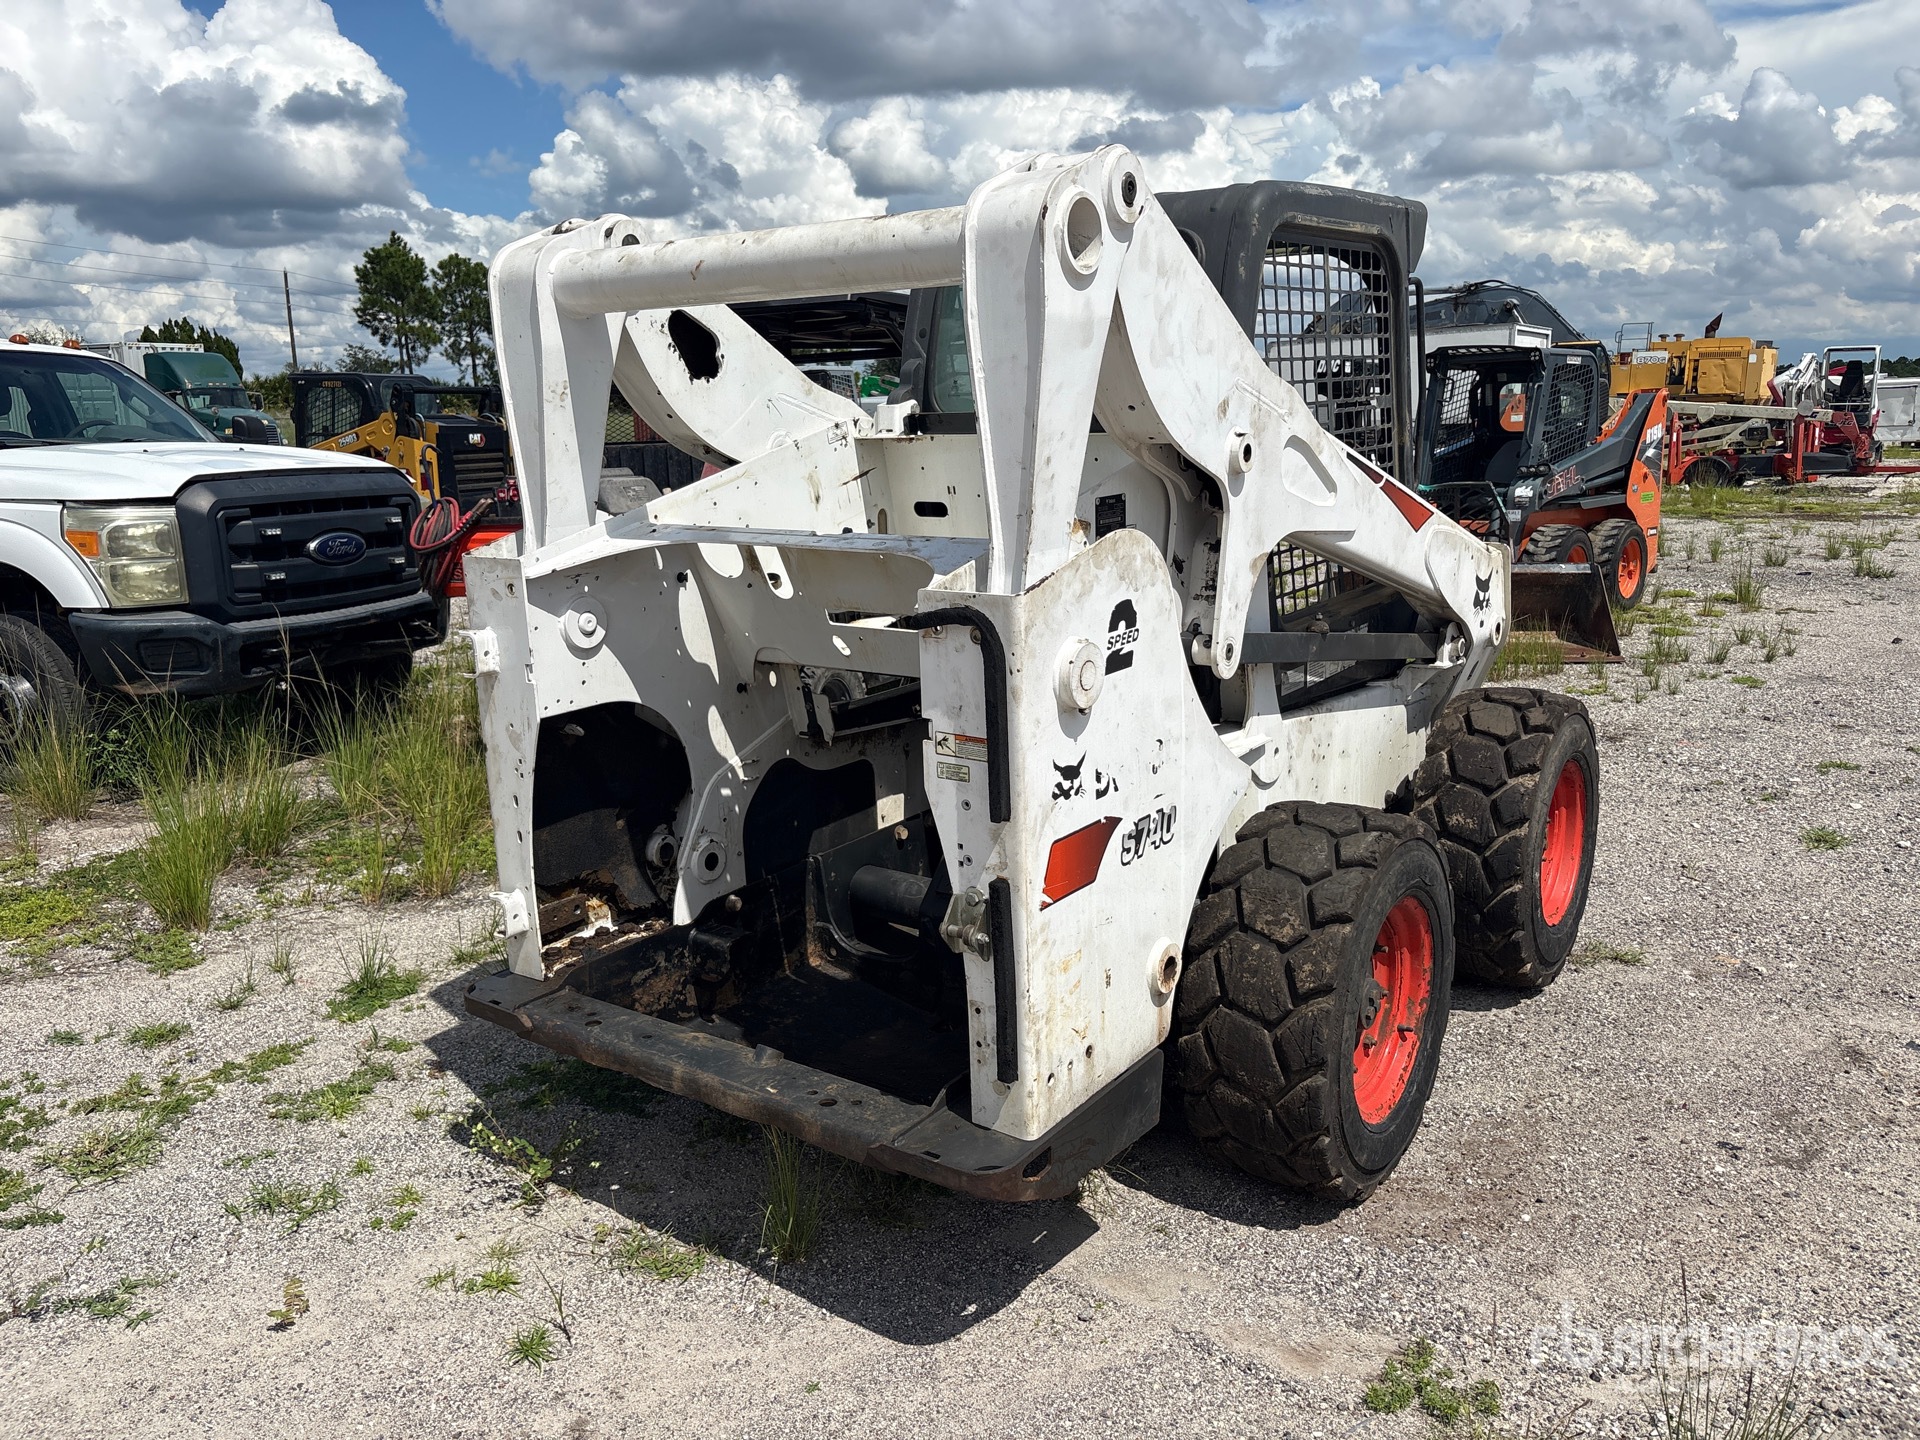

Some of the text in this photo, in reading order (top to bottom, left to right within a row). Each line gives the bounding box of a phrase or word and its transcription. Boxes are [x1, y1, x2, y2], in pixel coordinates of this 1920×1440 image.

[1636, 356, 1667, 365] 870G
[468, 433, 482, 445] CAT
[326, 538, 357, 556] Ford
[1106, 628, 1140, 650] SPEED
[1120, 805, 1177, 866] S740
